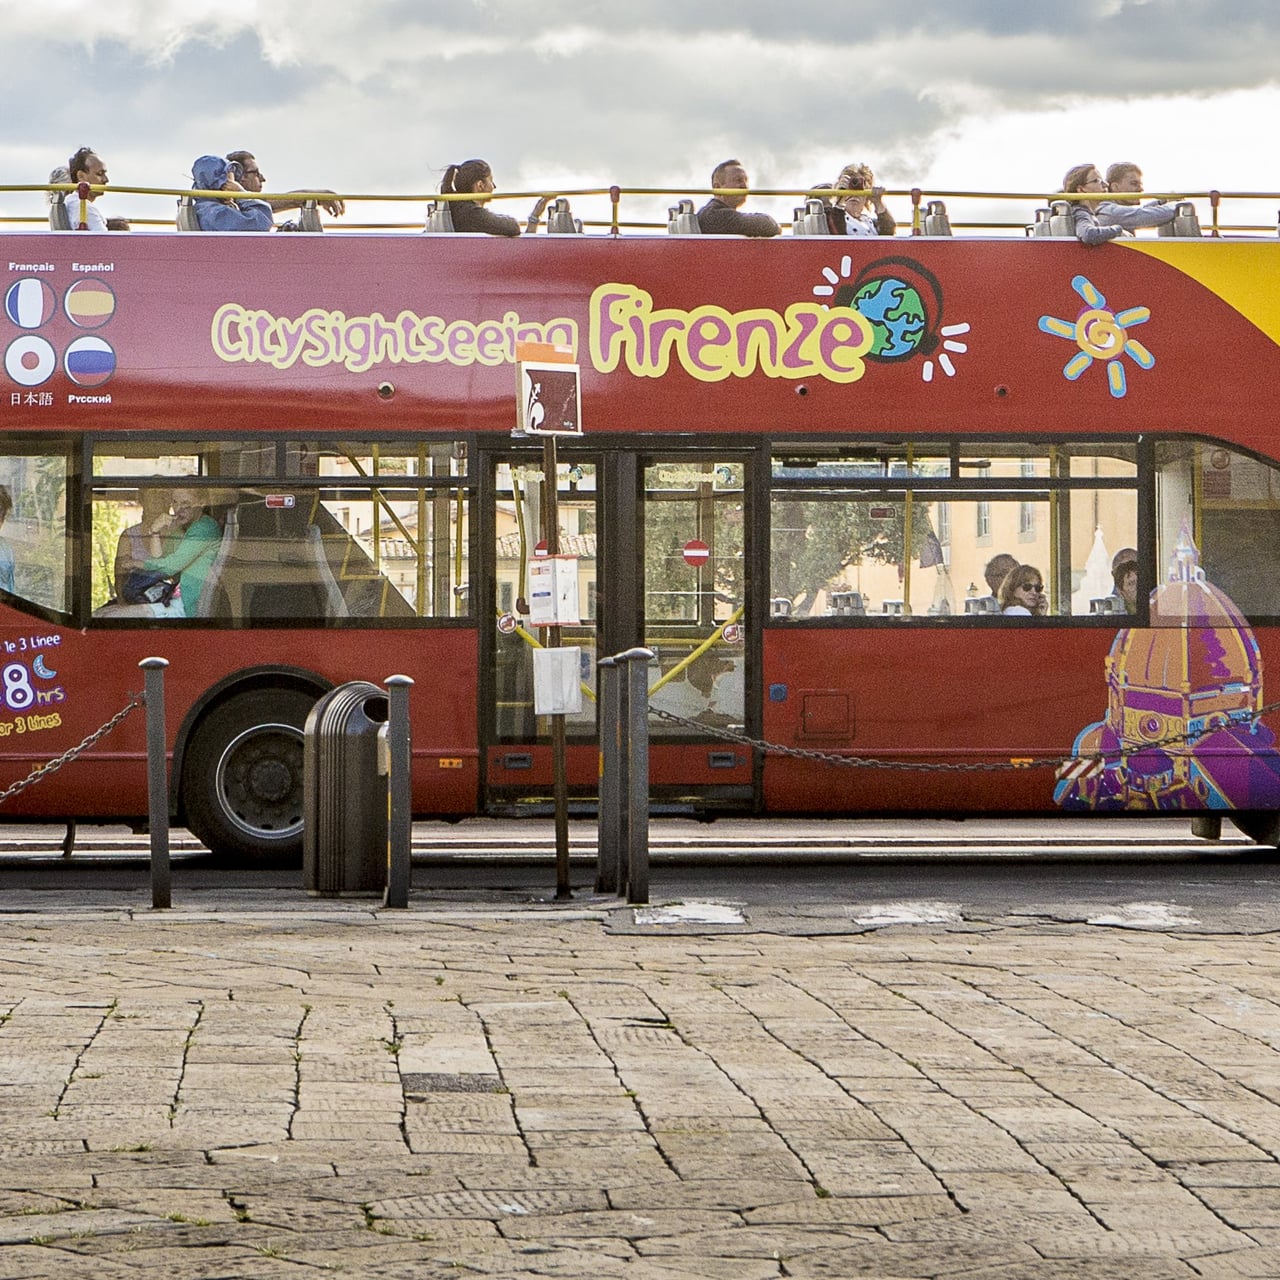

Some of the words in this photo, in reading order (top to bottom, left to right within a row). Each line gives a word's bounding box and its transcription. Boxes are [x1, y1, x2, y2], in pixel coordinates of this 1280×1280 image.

[8, 261, 56, 273] Français
[71, 262, 115, 273] Español
[593, 287, 869, 378] Firenze
[10, 391, 54, 407] 日本語
[3, 640, 17, 653] le
[19, 637, 28, 651] 3
[30, 634, 61, 649] Linee
[14, 716, 27, 734] 3
[27, 712, 62, 731] Lines
